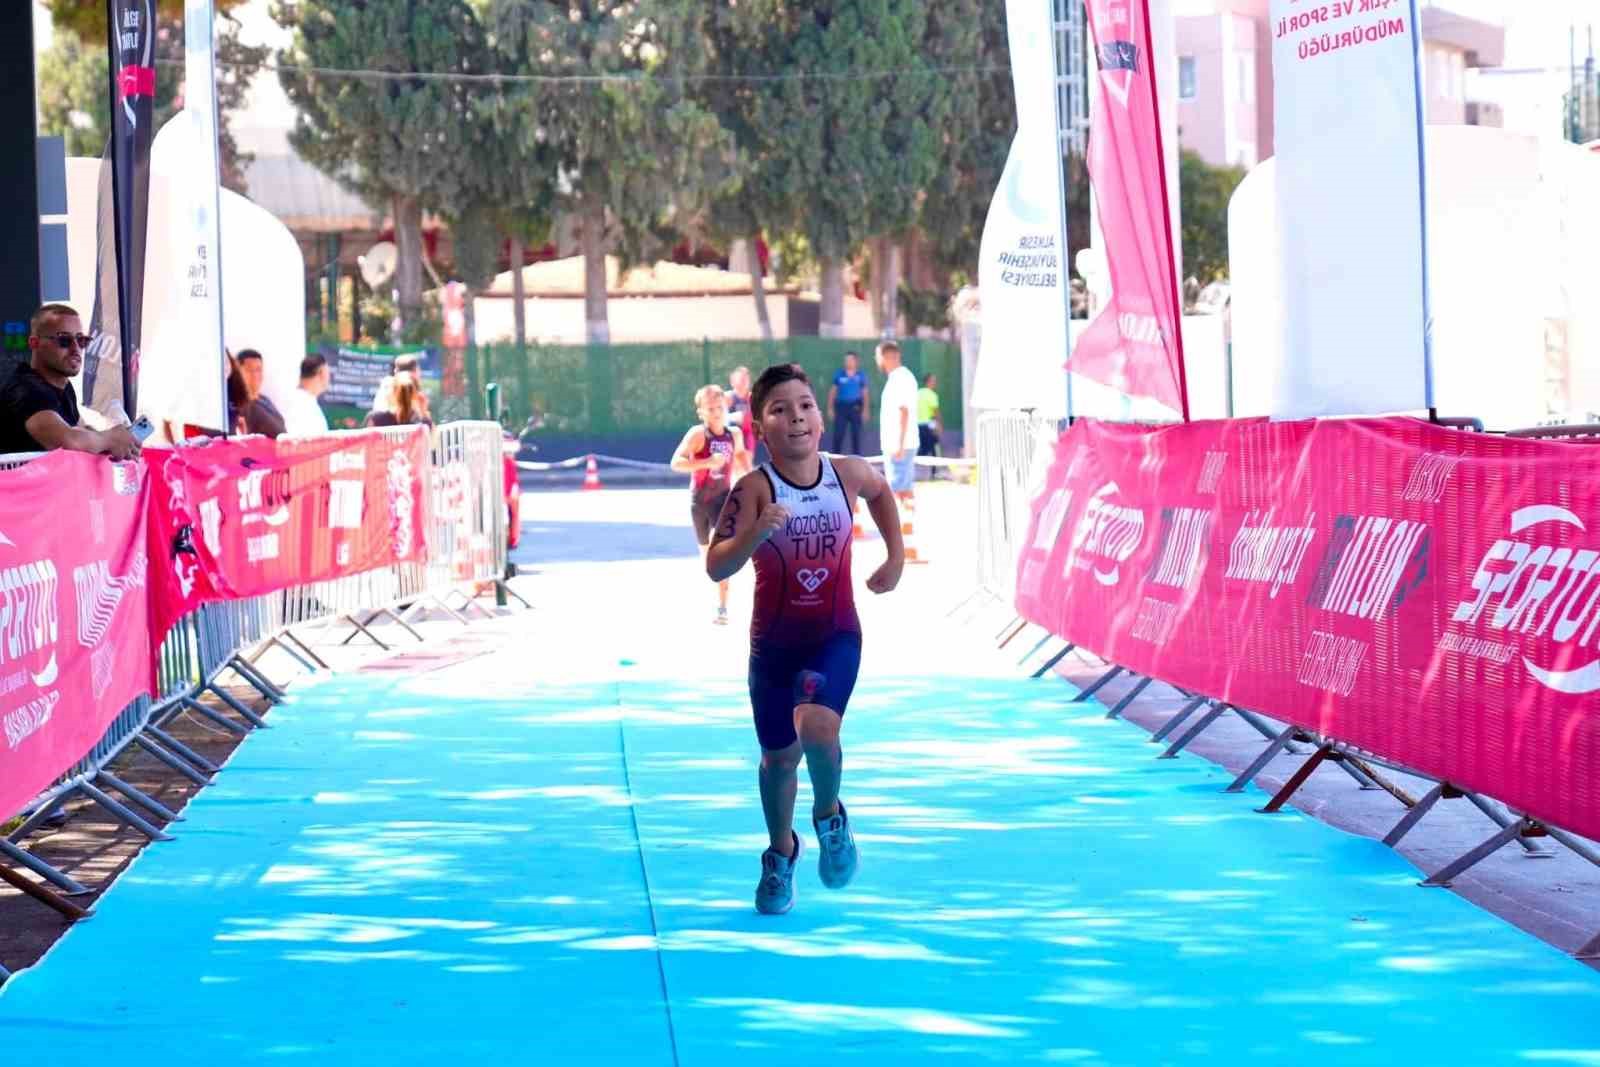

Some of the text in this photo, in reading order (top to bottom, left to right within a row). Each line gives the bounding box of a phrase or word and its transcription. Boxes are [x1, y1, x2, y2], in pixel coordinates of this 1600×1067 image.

[786, 510, 841, 537] KOZOĞLU
[791, 534, 836, 561] TUR
[0, 559, 58, 665] PORTOTO
[1452, 539, 1600, 648] SPORTO
